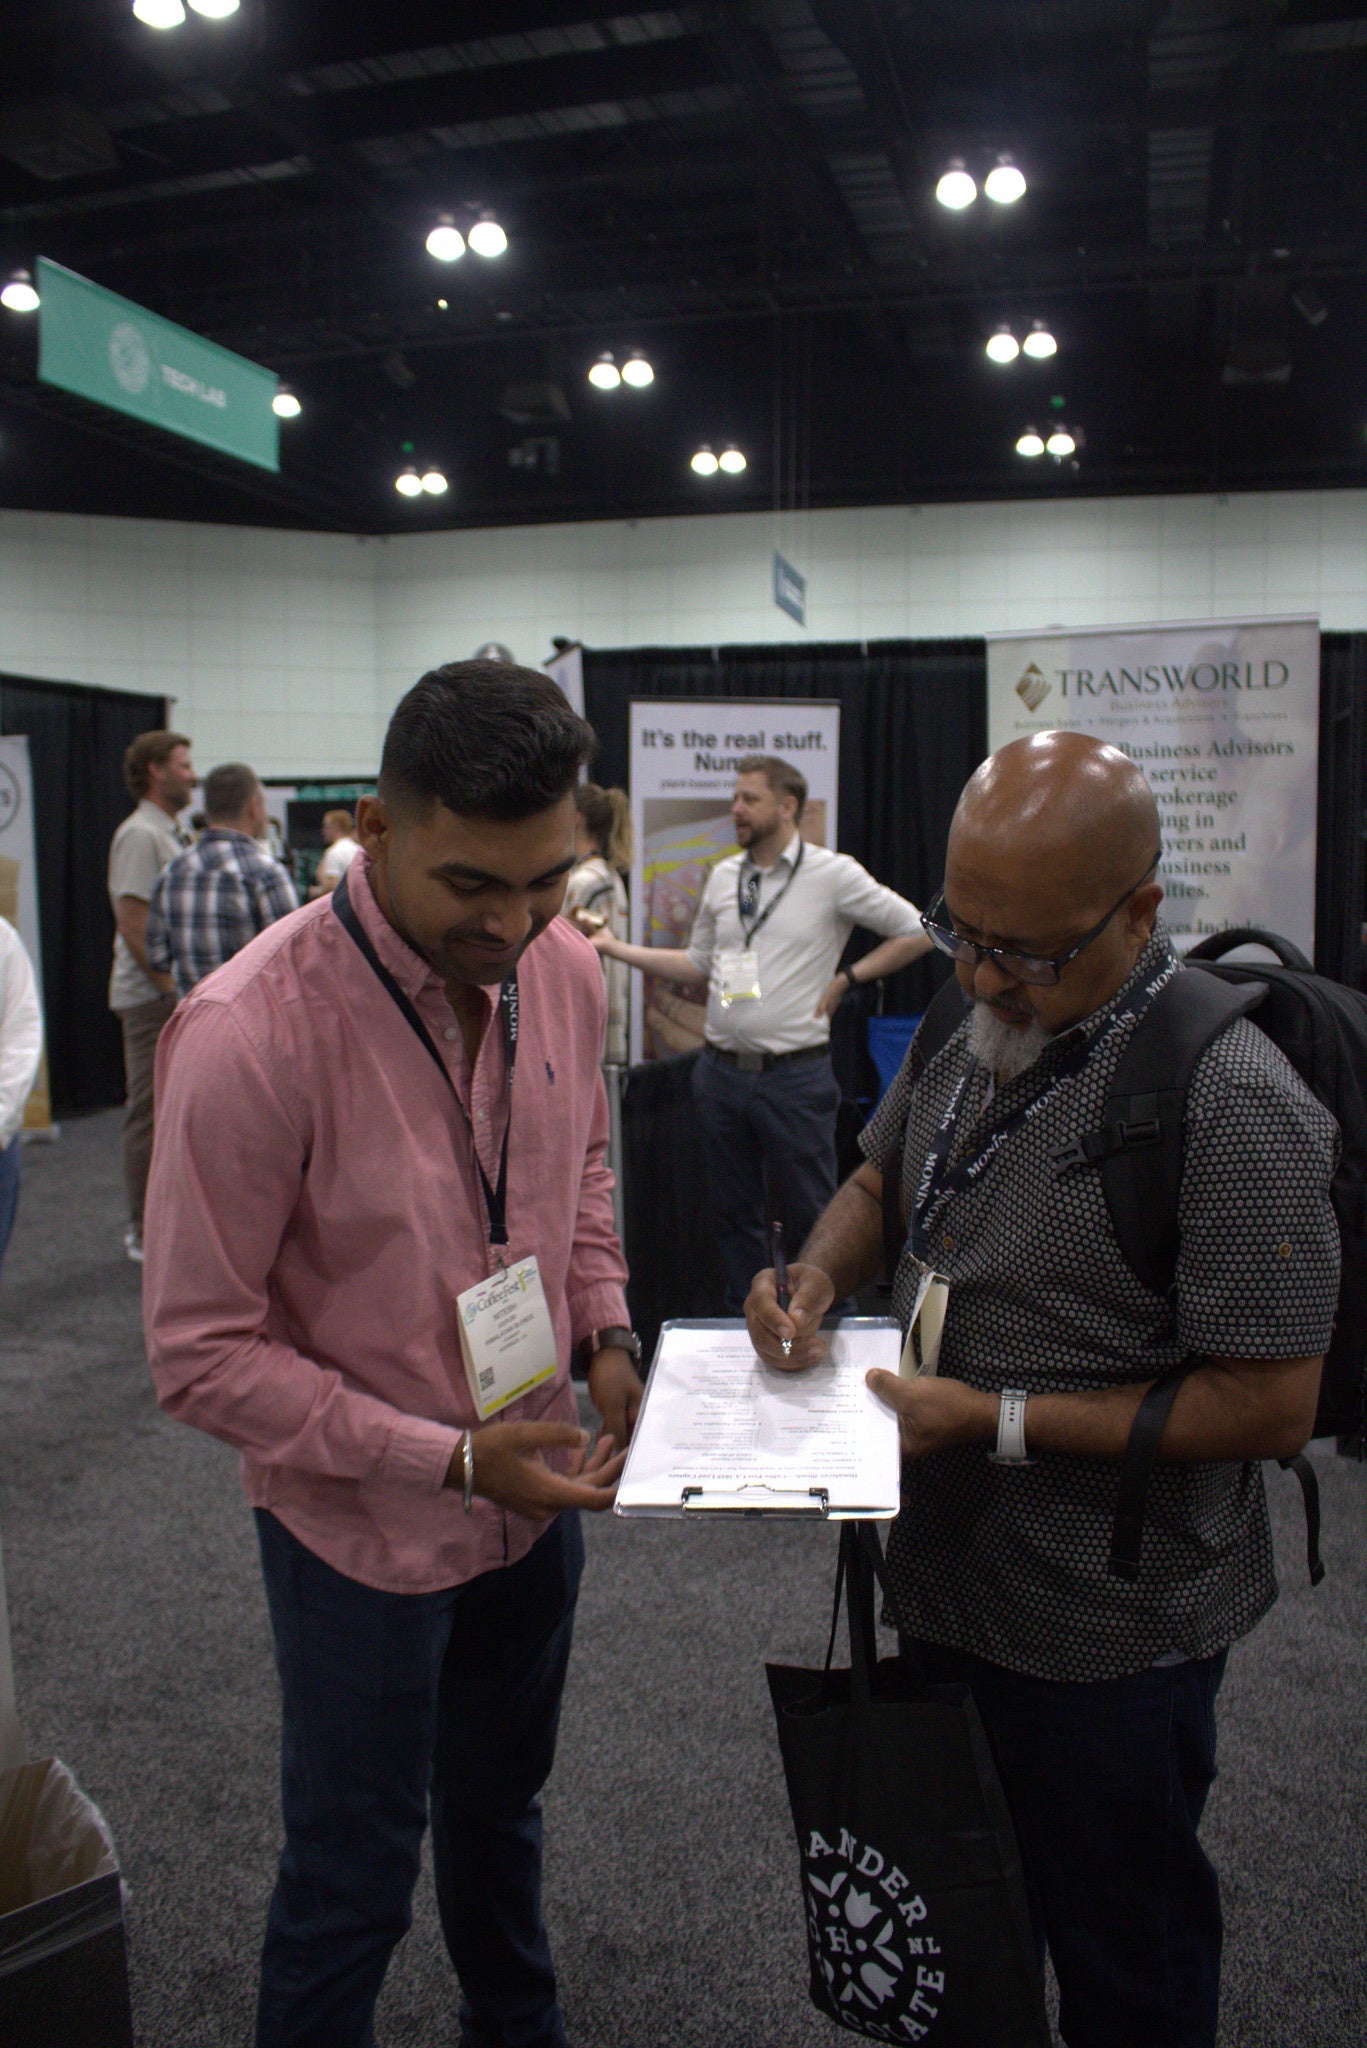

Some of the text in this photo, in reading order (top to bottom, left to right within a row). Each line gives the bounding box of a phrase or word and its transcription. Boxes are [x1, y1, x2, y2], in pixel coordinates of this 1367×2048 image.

[1055, 660, 1290, 698] TRANSWORLD
[641, 728, 674, 748] It's
[682, 728, 718, 749] the
[724, 730, 765, 749] real
[1119, 739, 1294, 760] Business Advisors
[1150, 764, 1217, 783] service
[1154, 787, 1239, 808] rokerage
[1195, 811, 1214, 828] in
[1210, 833, 1246, 851] and
[1156, 858, 1231, 876] usiness
[806, 1827, 927, 1928] ANDER
